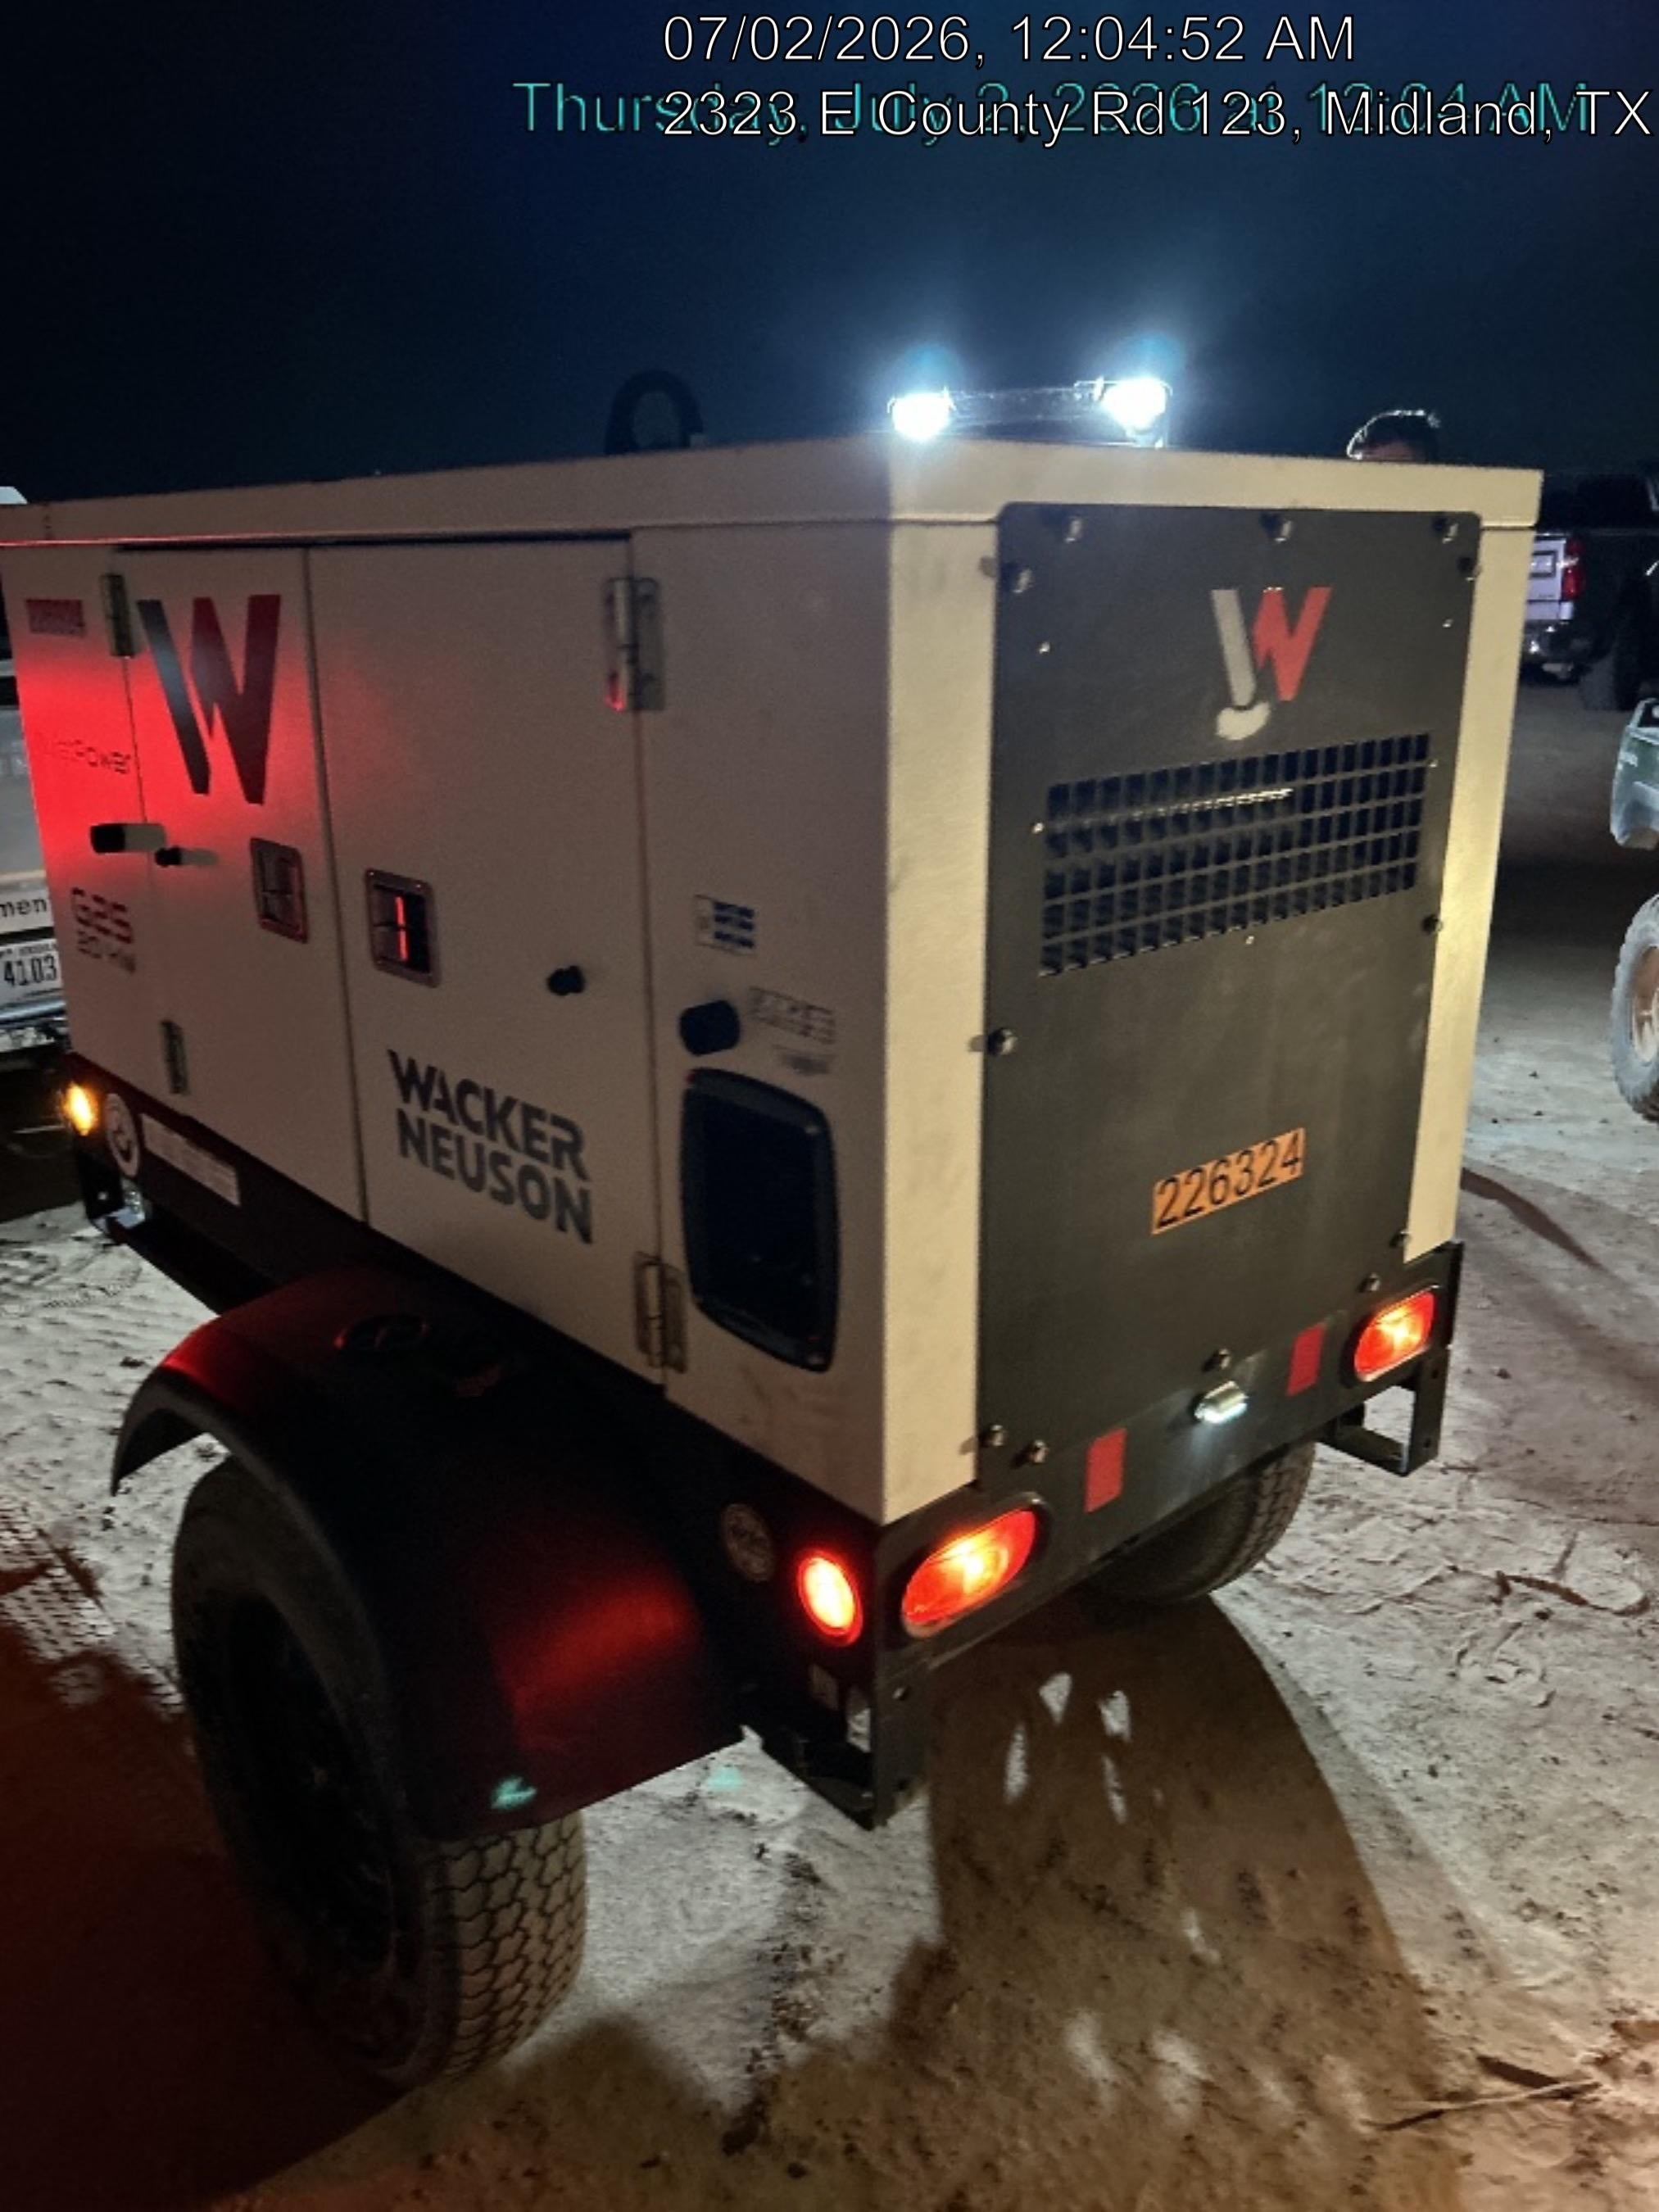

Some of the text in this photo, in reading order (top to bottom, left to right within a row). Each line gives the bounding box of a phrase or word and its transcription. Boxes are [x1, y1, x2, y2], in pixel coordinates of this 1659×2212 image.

[388, 1049, 590, 1182] WACKER
[397, 1107, 593, 1245] NEUSON
[1156, 1131, 1301, 1228] 226324
